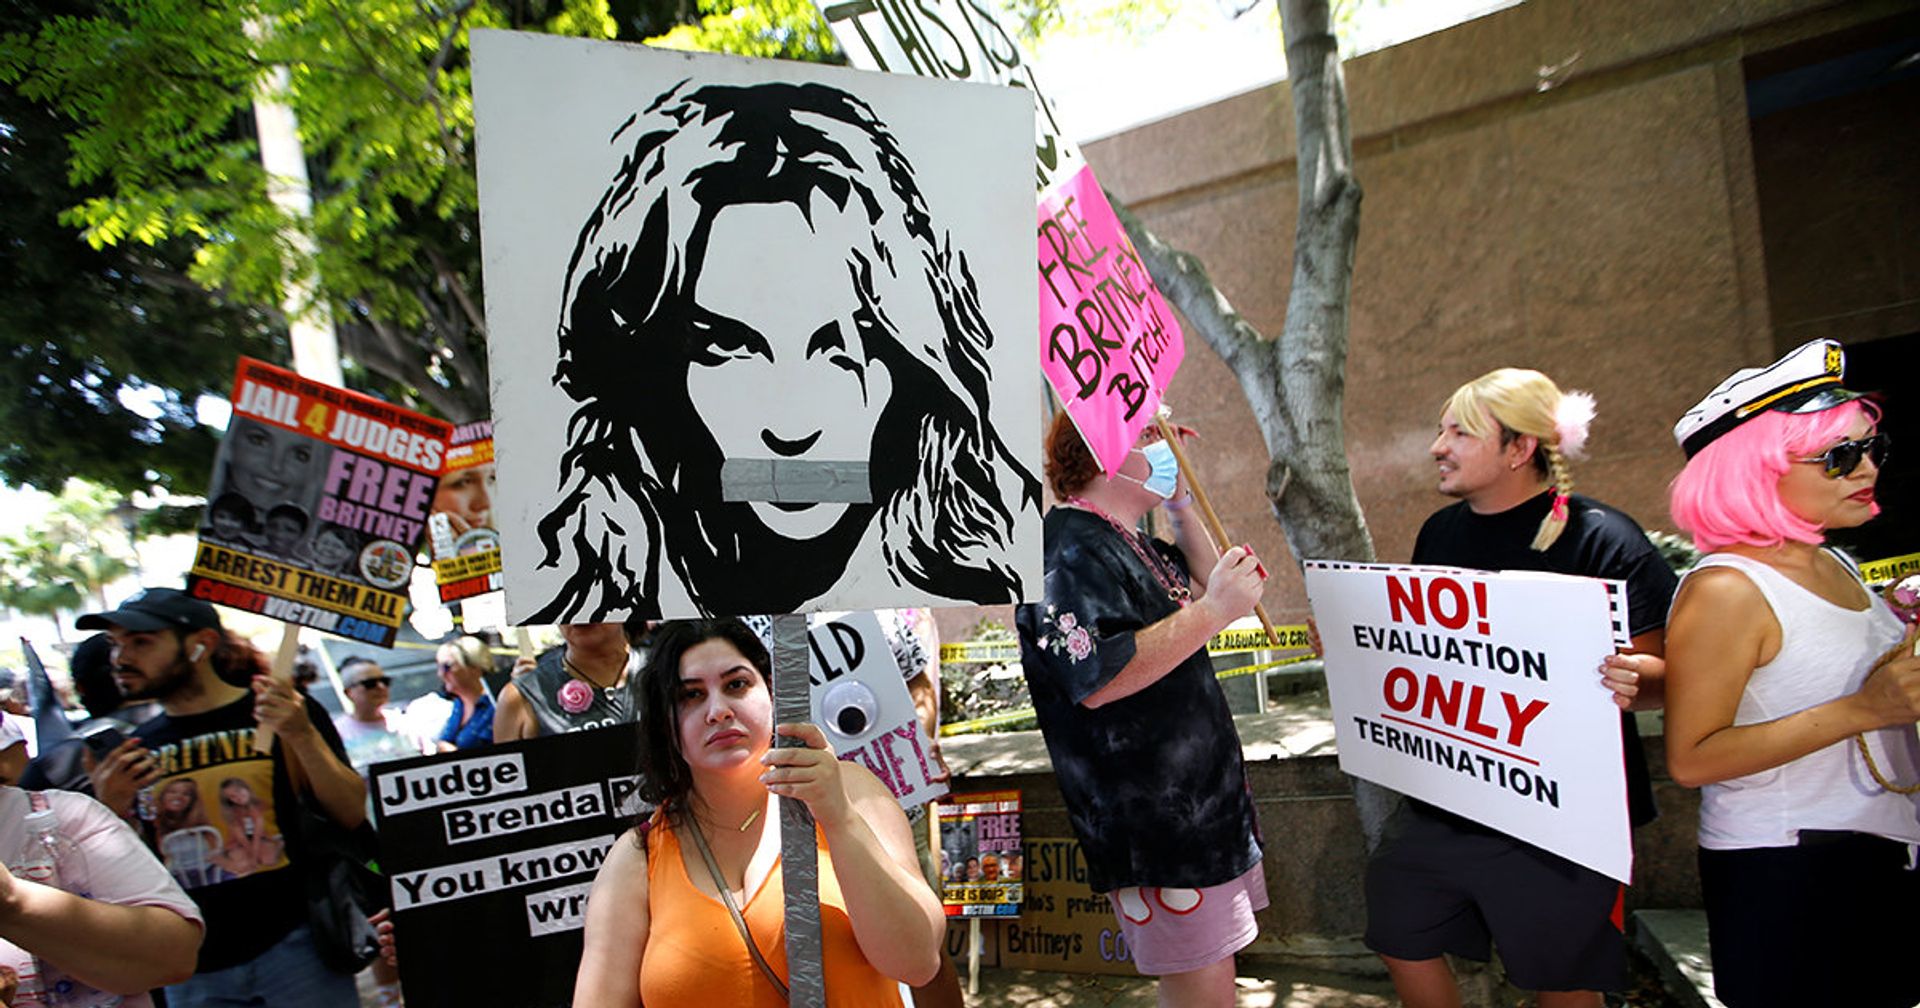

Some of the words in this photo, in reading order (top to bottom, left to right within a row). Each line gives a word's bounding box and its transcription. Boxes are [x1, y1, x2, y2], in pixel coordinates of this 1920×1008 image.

[1038, 196, 1108, 308] FREE
[1050, 243, 1157, 400] BRITNEY
[1106, 298, 1171, 422] BITCH!
[236, 380, 300, 427] JAIL
[304, 403, 329, 435] 4
[329, 409, 444, 471] JUDGES
[323, 448, 436, 522] FREE
[318, 495, 424, 547] BRITNEY
[197, 545, 291, 594] ARREST
[297, 570, 359, 608] THEM
[361, 589, 397, 619] ALL
[1386, 575, 1491, 636] NO!
[808, 622, 865, 687] LD
[1353, 625, 1549, 681] EVALUATION
[1383, 667, 1549, 747] ONLY
[383, 761, 519, 807] Judge
[837, 719, 934, 799] NEY
[1353, 717, 1560, 808] TERMINATION
[447, 791, 600, 841] Brenda
[977, 815, 1020, 838] FREE
[396, 869, 485, 904] You
[499, 844, 613, 886] know
[1023, 842, 1088, 883] ESTIG
[531, 894, 590, 923] wr
[1024, 887, 1055, 912] ho's
[1099, 927, 1134, 963] CO
